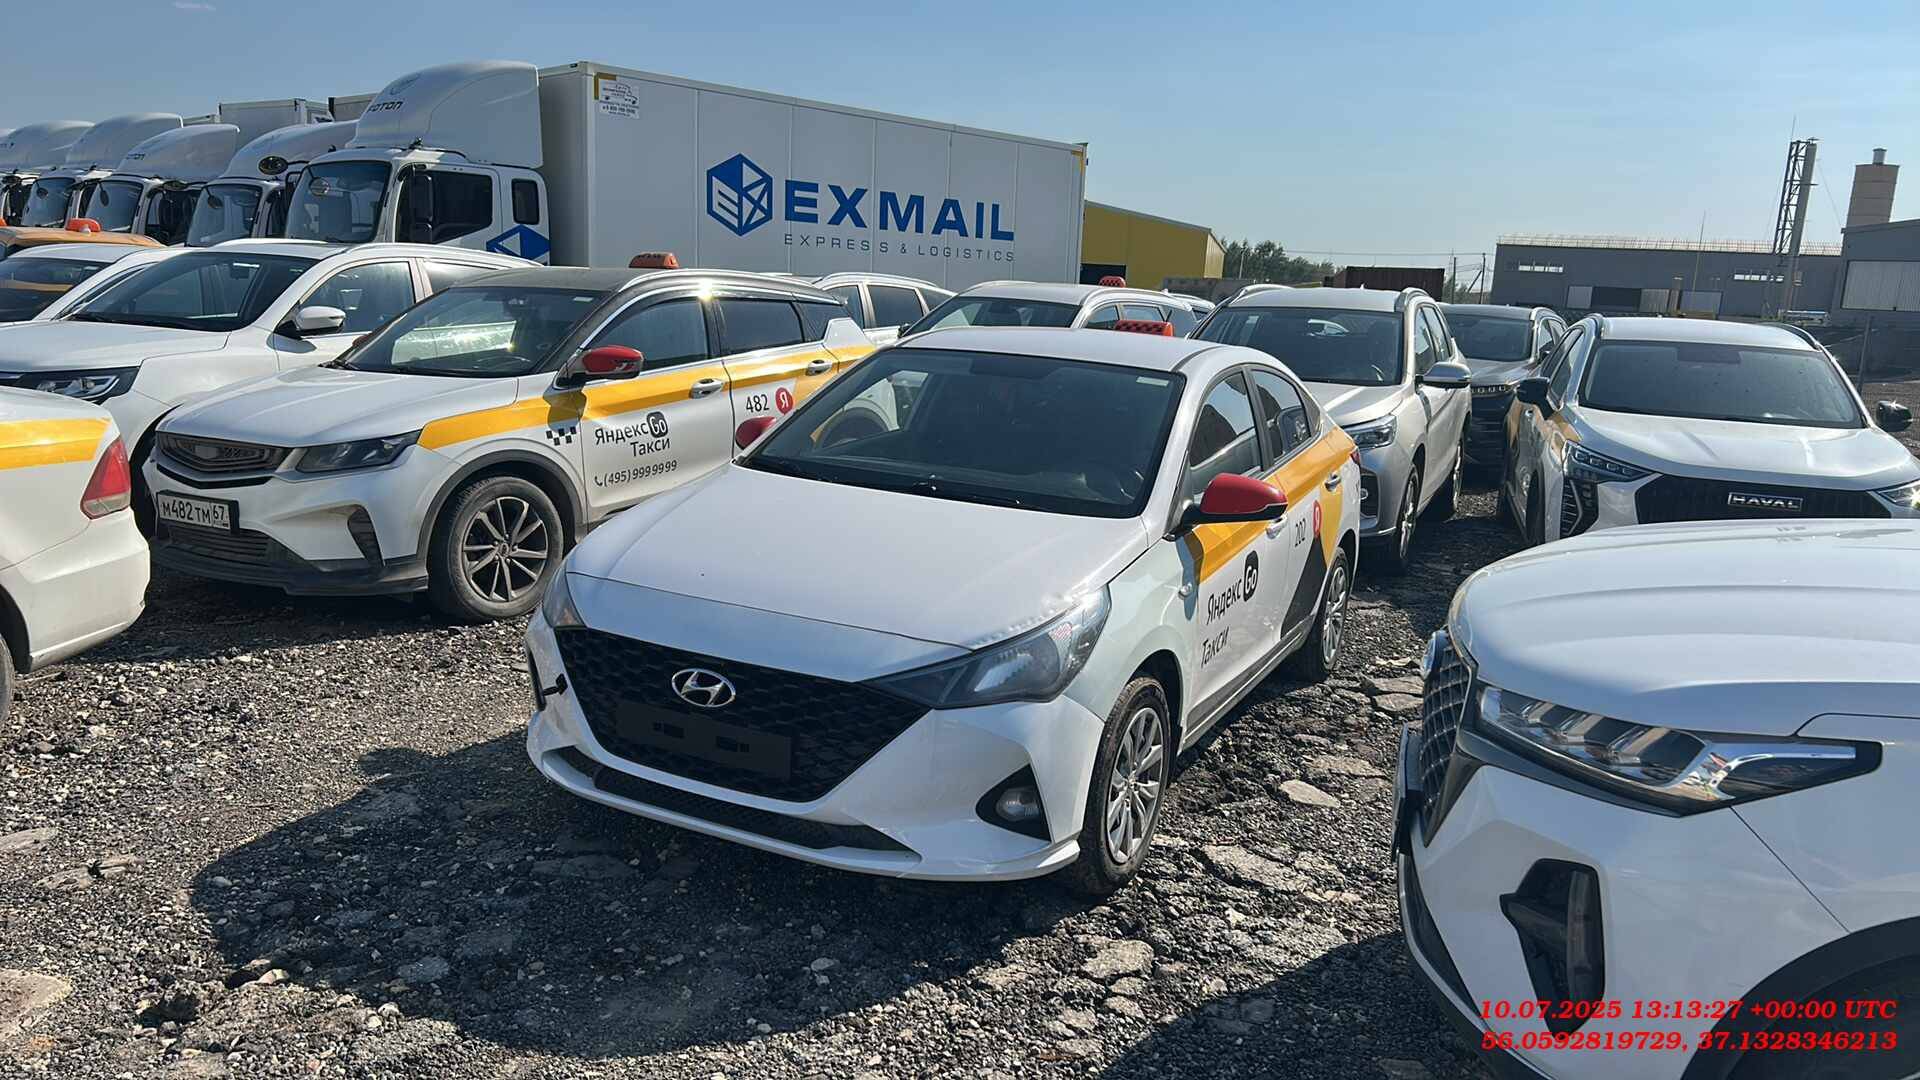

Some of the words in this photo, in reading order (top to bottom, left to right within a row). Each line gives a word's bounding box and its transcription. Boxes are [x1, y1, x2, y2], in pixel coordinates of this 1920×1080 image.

[785, 179, 1014, 241] EXMAIL
[785, 234, 888, 252] EXPRESS
[900, 243, 908, 254] &
[919, 245, 1014, 262] LOGISTICS
[746, 394, 769, 413] 482
[595, 421, 648, 446] Яндекс
[649, 414, 668, 436] Go
[630, 437, 670, 458] Такси
[213, 505, 224, 521] 67
[1732, 495, 1799, 508] HAVAL
[1294, 517, 1307, 548] 202
[1206, 579, 1242, 625] Яндекс
[1244, 564, 1258, 596] Go
[1201, 627, 1230, 669] Такси
